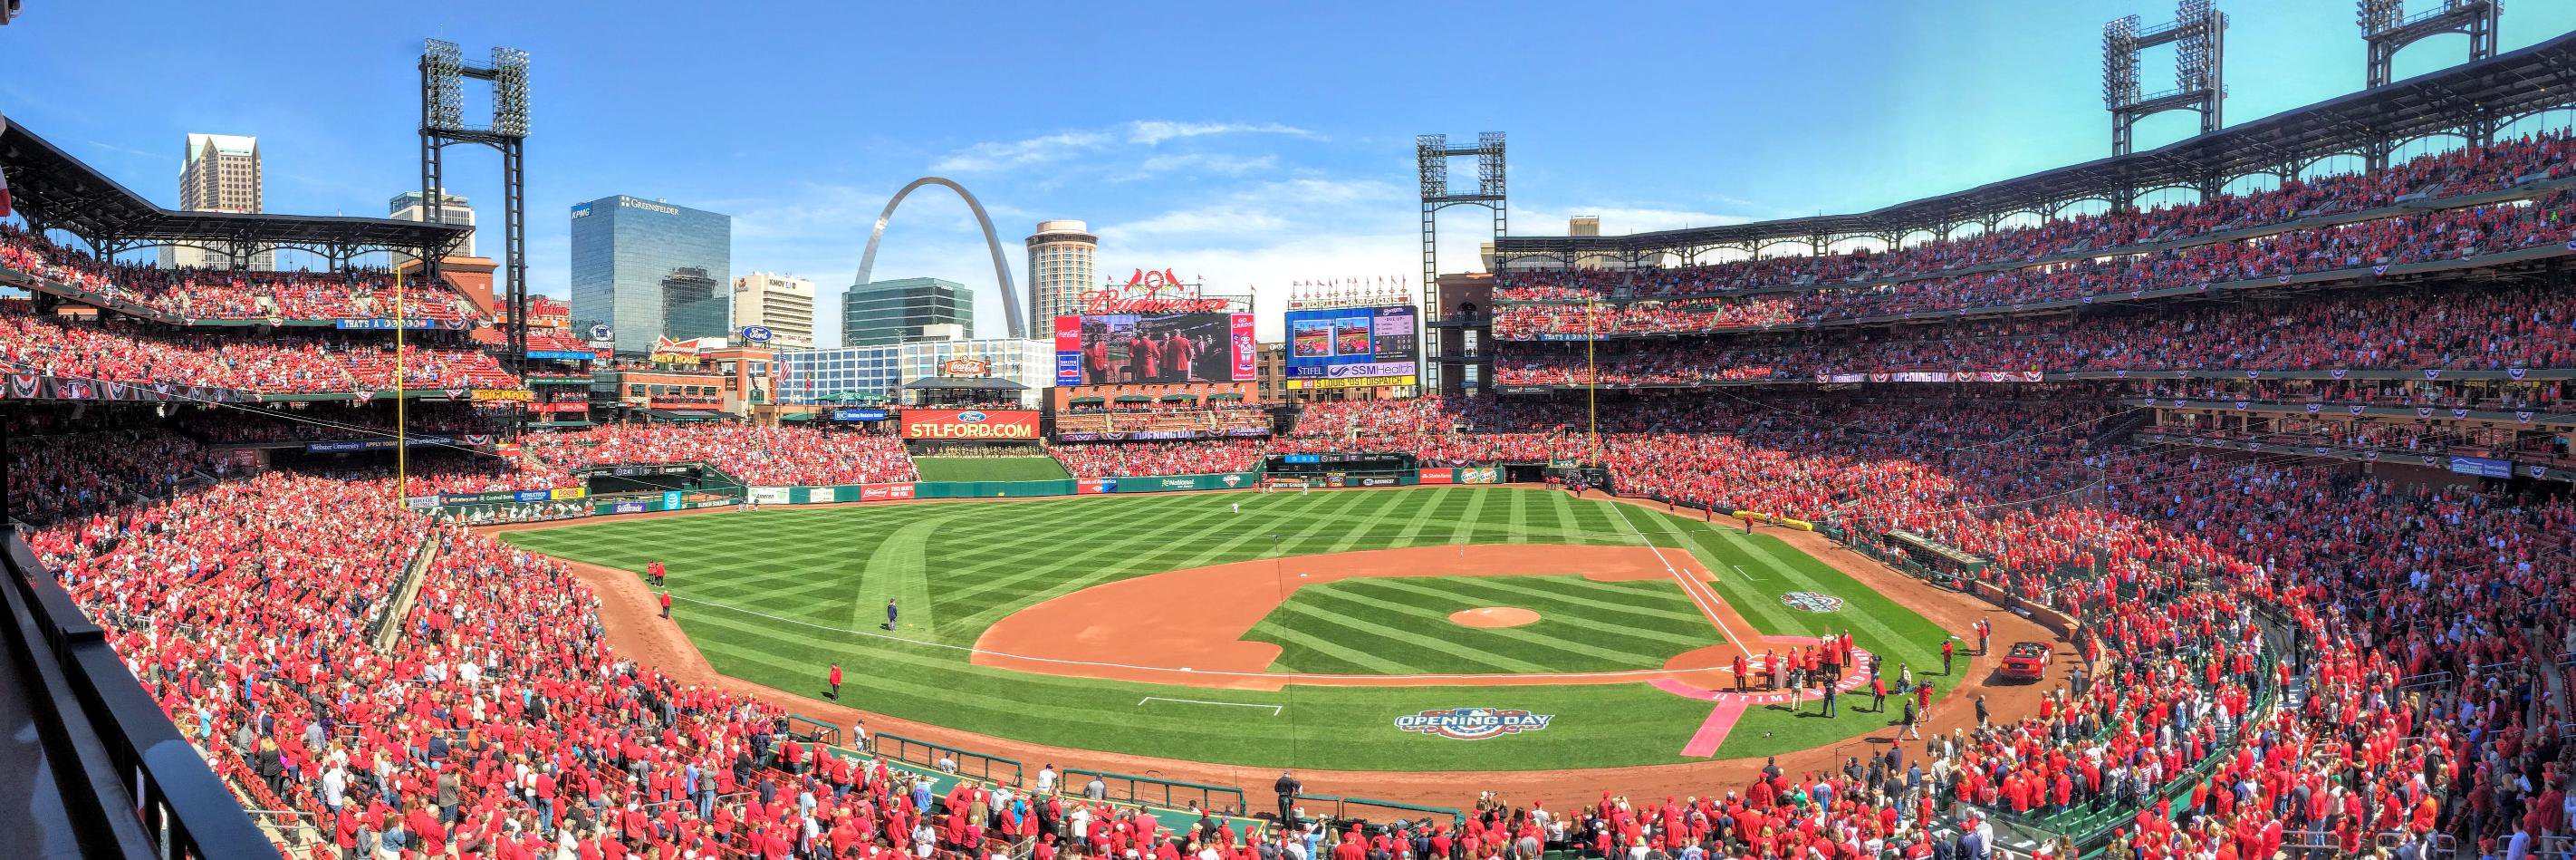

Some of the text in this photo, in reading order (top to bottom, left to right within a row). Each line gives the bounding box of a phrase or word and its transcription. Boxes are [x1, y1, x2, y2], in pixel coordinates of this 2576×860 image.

[631, 199, 678, 216] GREENSFELDER
[572, 208, 590, 219] KPMG
[1079, 289, 1230, 314] Budweiser
[528, 298, 568, 317] Nation
[344, 320, 369, 328] THAT'S
[374, 320, 380, 328] A
[750, 328, 768, 339] Ford
[1057, 329, 1079, 338] Coca-Cola
[589, 341, 615, 349] MIDWEST
[652, 340, 699, 353] Budweiser
[652, 354, 701, 364] BREW HOUSE
[951, 362, 980, 372] Coca-Cola
[1297, 367, 1322, 375] STIFEL
[1931, 372, 1947, 382] DAY
[1324, 379, 1345, 387] LOUIS
[501, 391, 528, 401] MAC
[911, 423, 1032, 437] STLFORD.COM
[1133, 430, 1197, 440] OPENING DAY
[333, 443, 359, 451] University
[1462, 472, 1478, 480] Gulf
[617, 503, 642, 512] Scottrade
[1504, 716, 1551, 726] DAY
